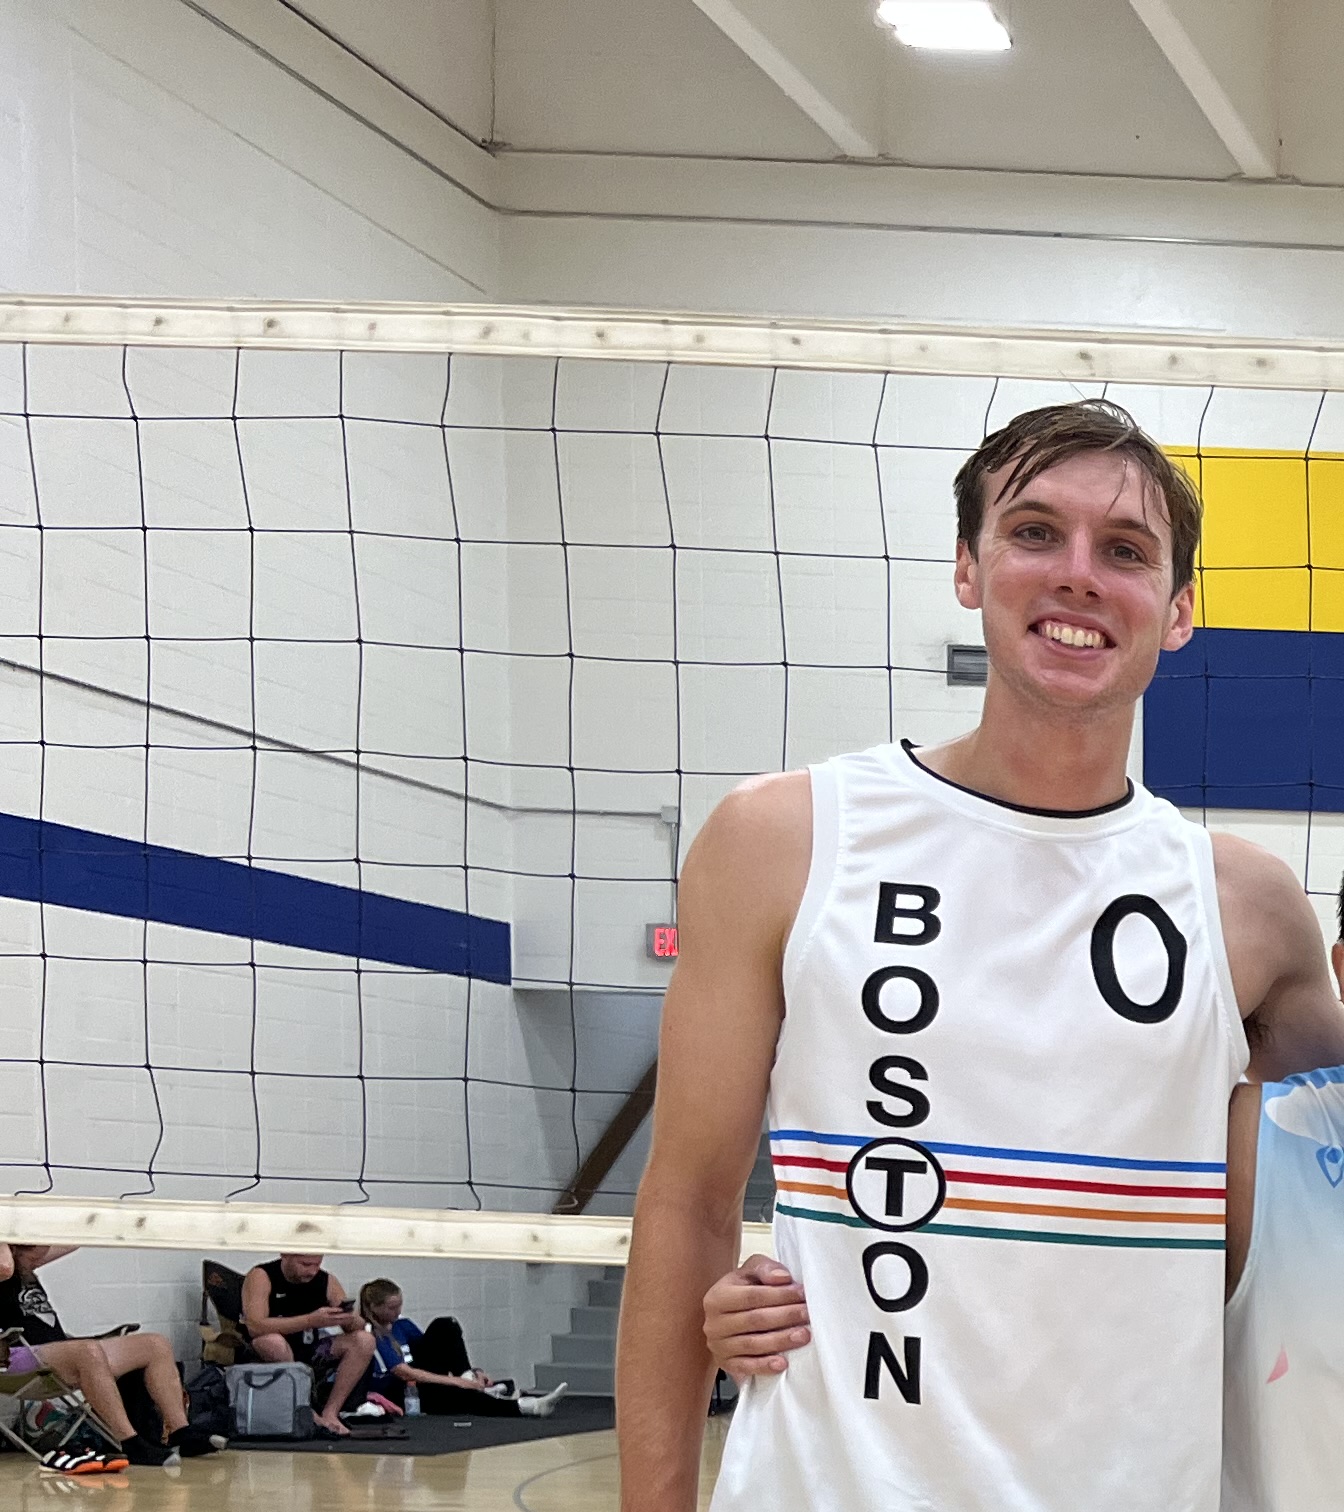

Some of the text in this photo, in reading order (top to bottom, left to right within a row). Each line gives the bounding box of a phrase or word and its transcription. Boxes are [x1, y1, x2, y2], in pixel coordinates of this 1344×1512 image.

[654, 928, 679, 956] EX
[1090, 893, 1188, 1024] 0
[860, 880, 942, 1405] BOSTON
